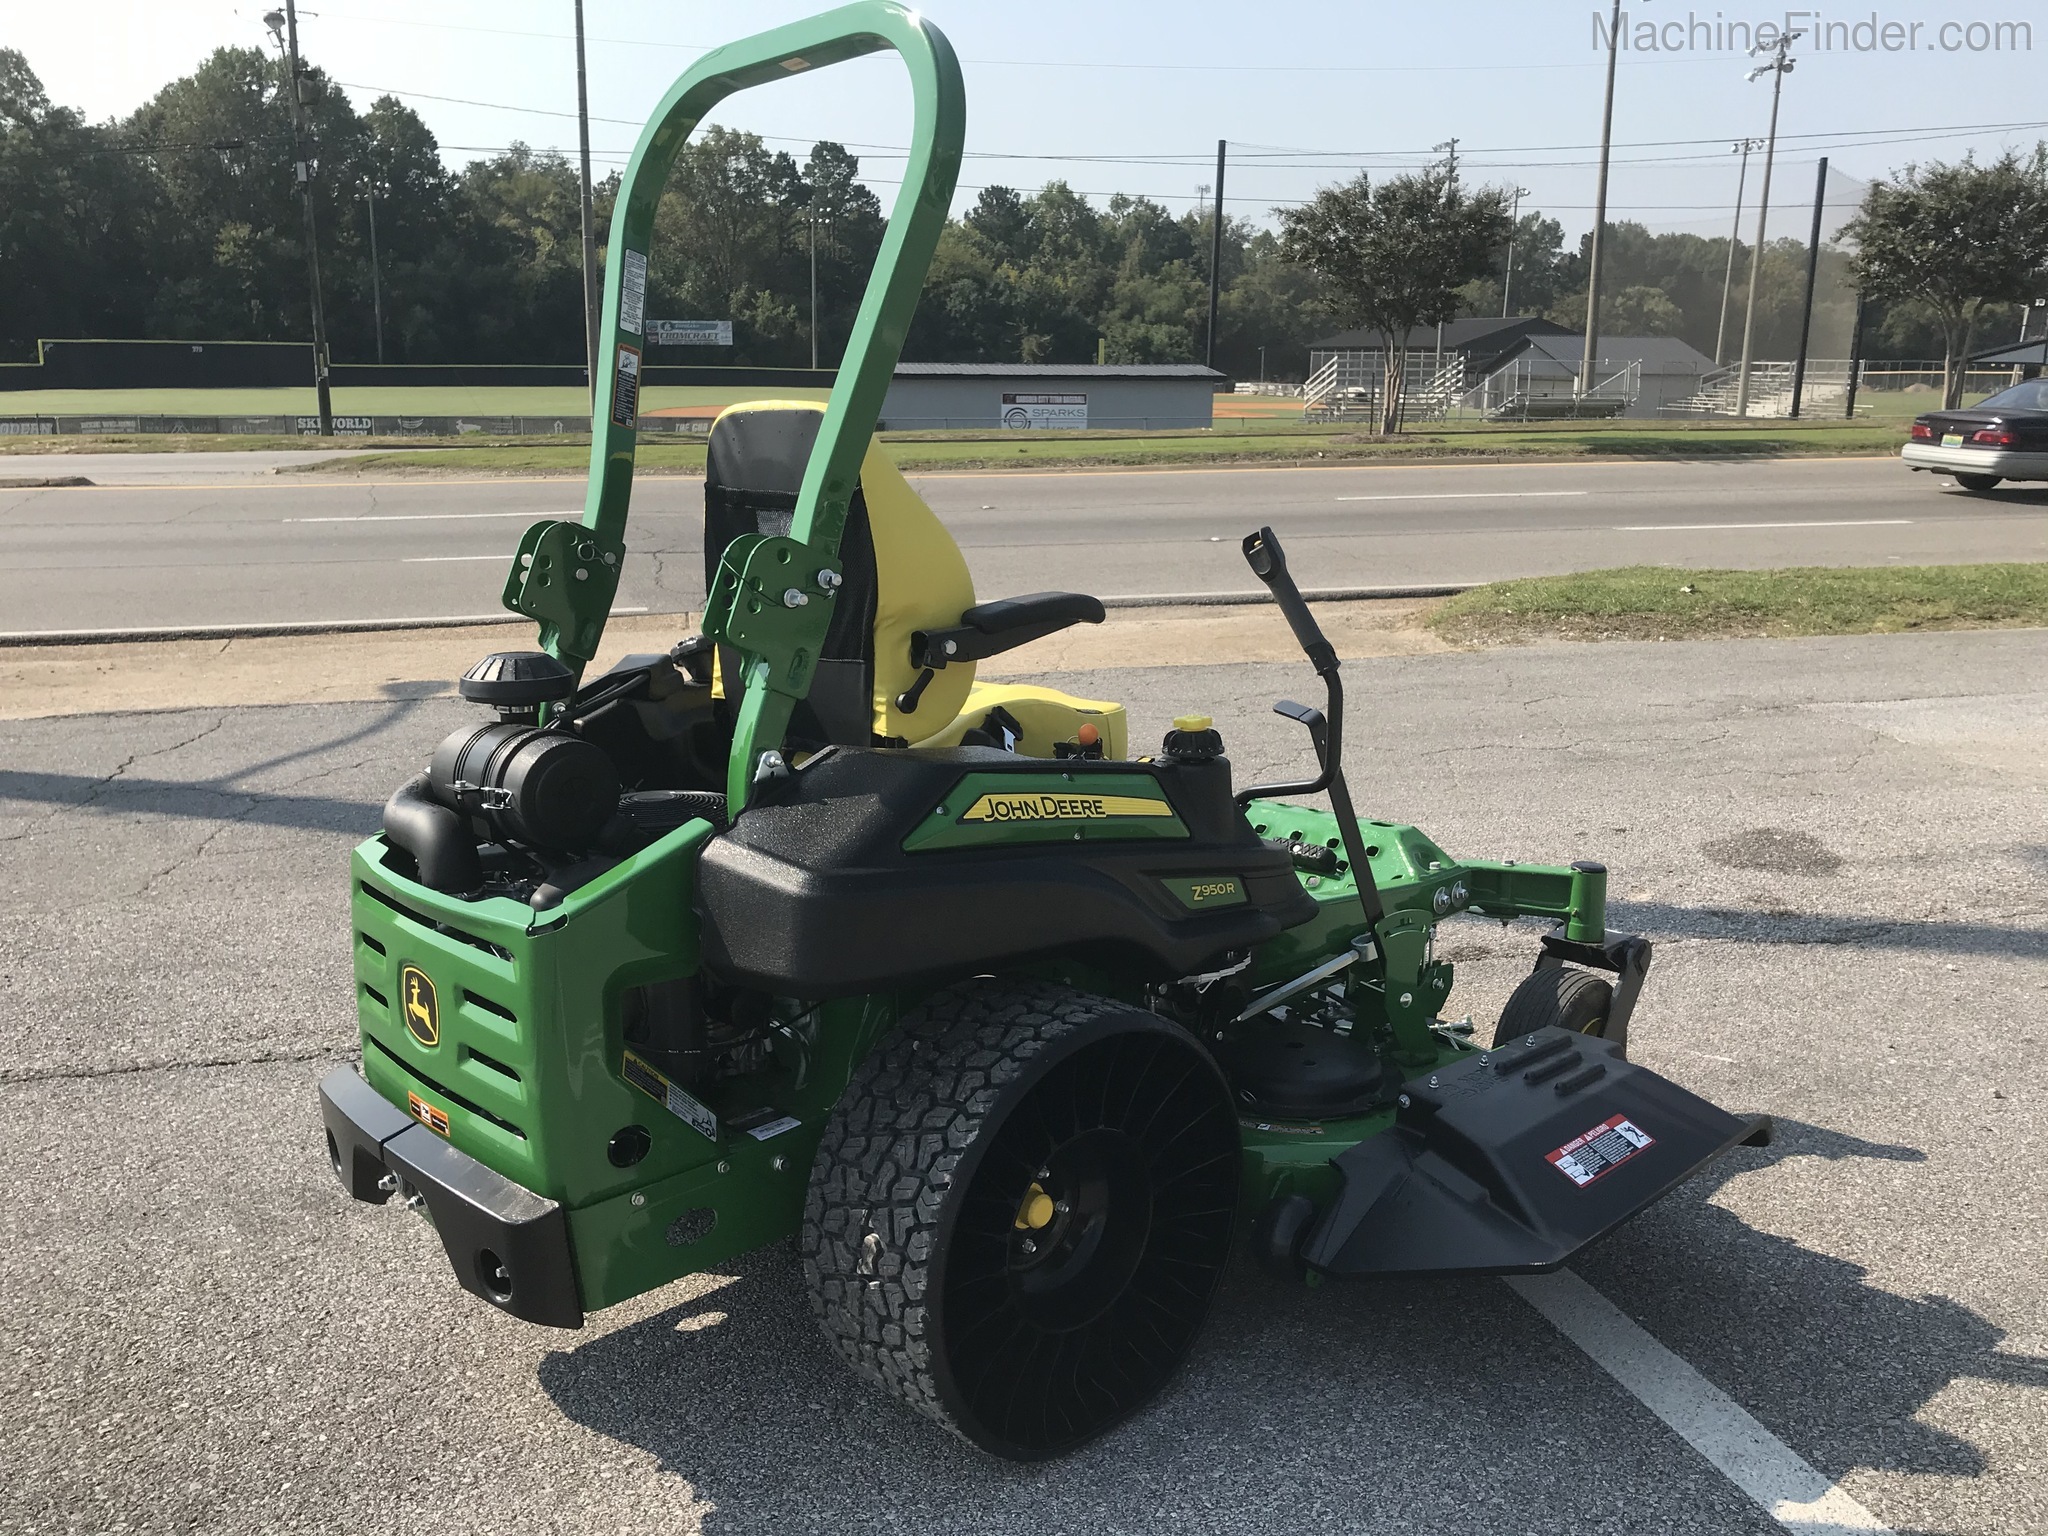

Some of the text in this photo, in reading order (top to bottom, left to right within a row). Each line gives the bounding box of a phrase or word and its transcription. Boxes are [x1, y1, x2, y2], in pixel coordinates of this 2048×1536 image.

[1032, 408, 1086, 417] SPARKS
[985, 796, 1106, 819] JOHN DEERE
